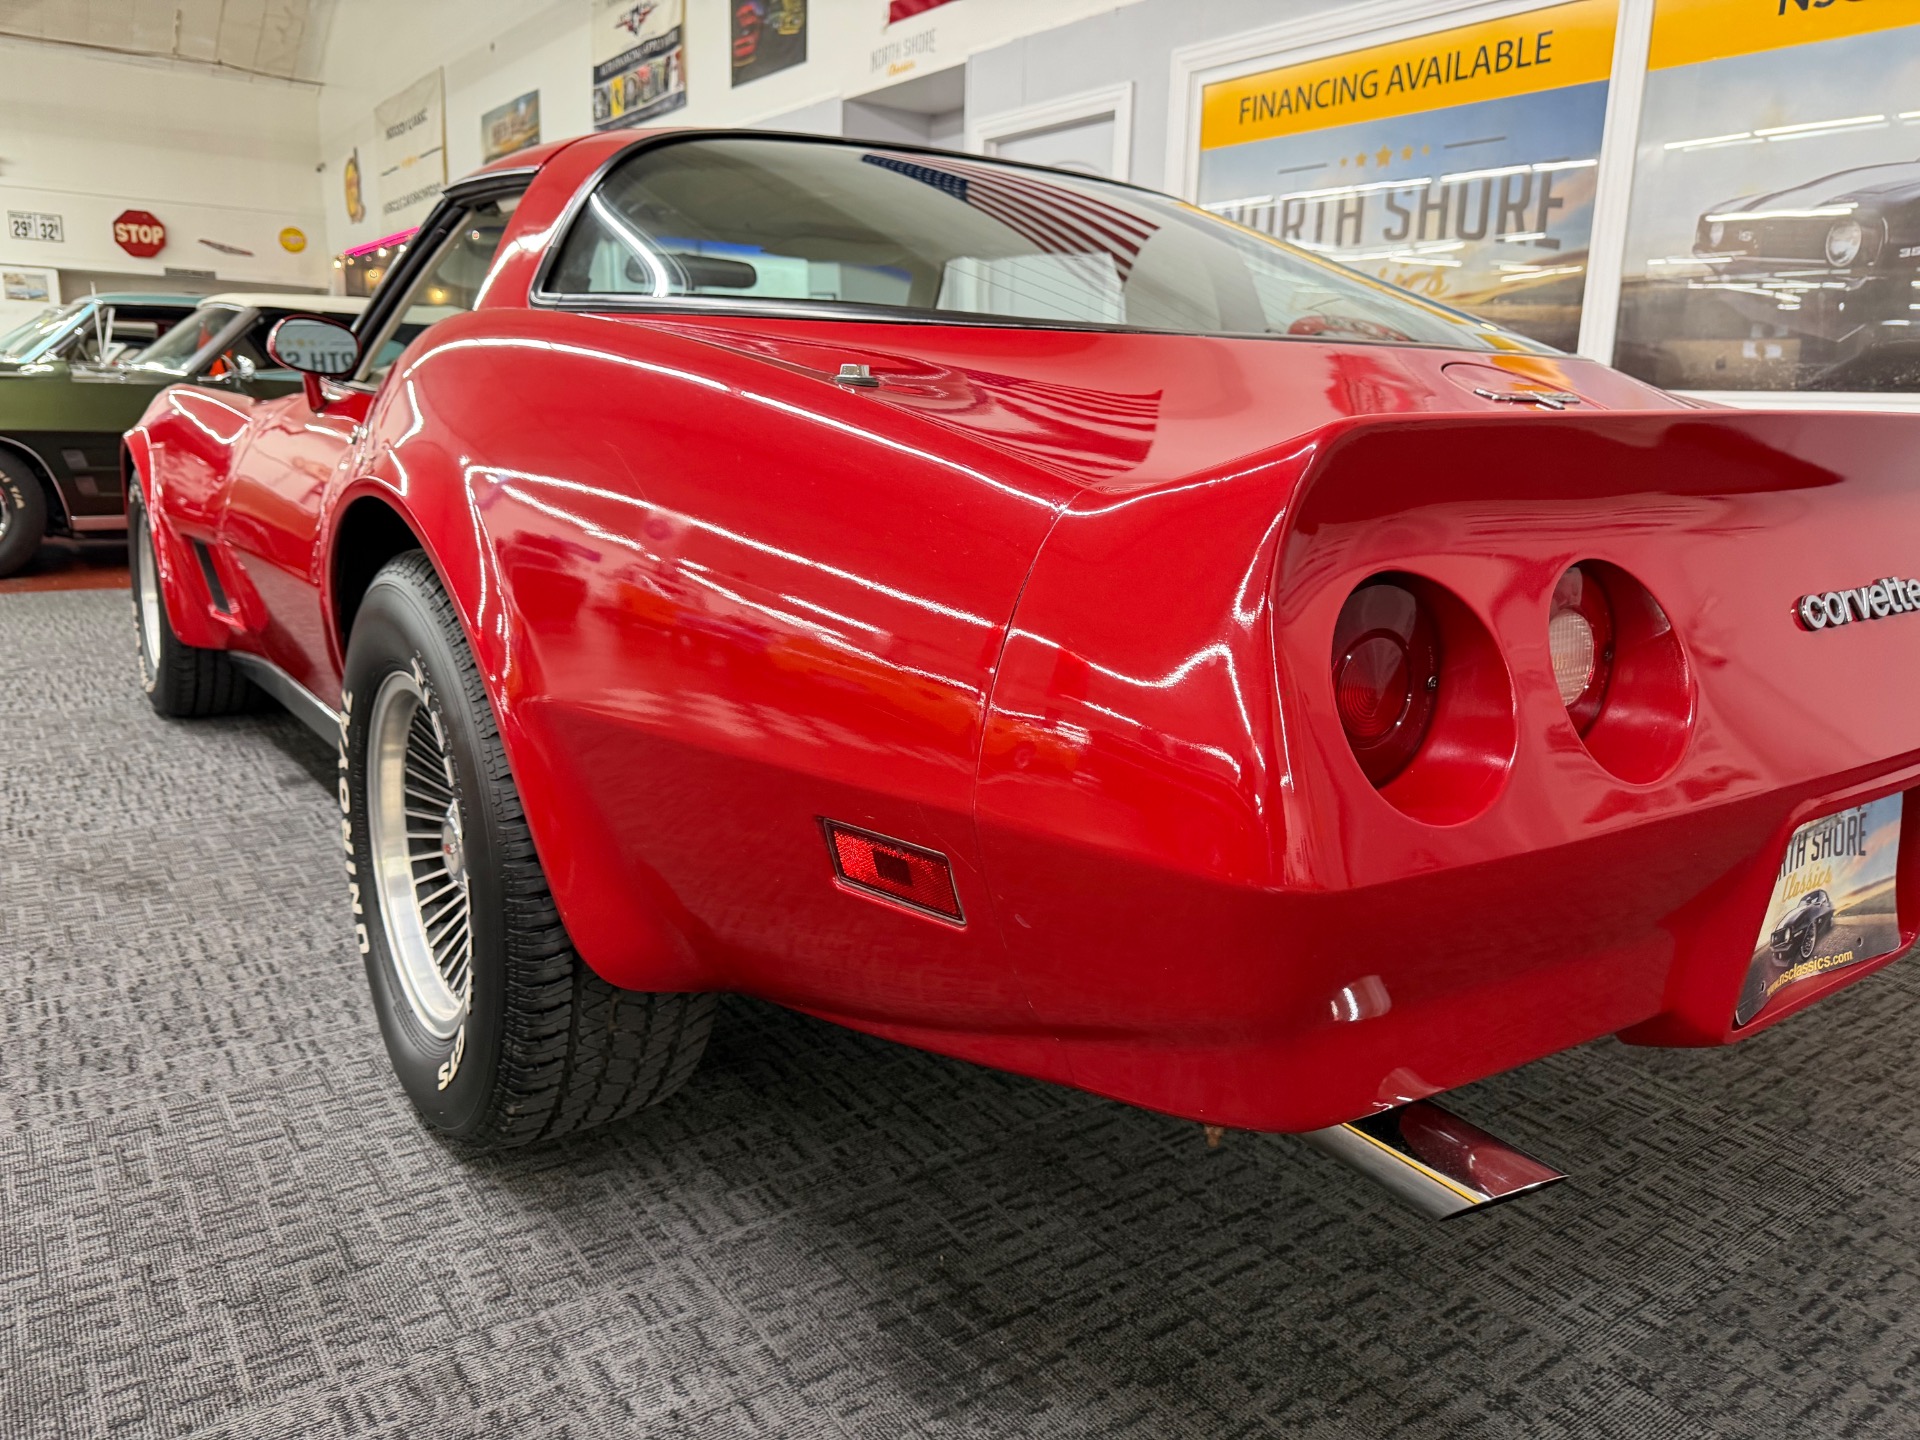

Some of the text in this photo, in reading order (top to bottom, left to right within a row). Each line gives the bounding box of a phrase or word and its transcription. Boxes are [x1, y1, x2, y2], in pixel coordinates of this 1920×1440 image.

[1239, 30, 1554, 125] FINANCING AVAILABLE
[115, 222, 164, 245] STOP
[1797, 576, 1920, 631] corvette
[1811, 812, 1867, 862] SHORE
[1782, 865, 1834, 903] Classics
[1766, 950, 1854, 997] www.nsclassics.com
